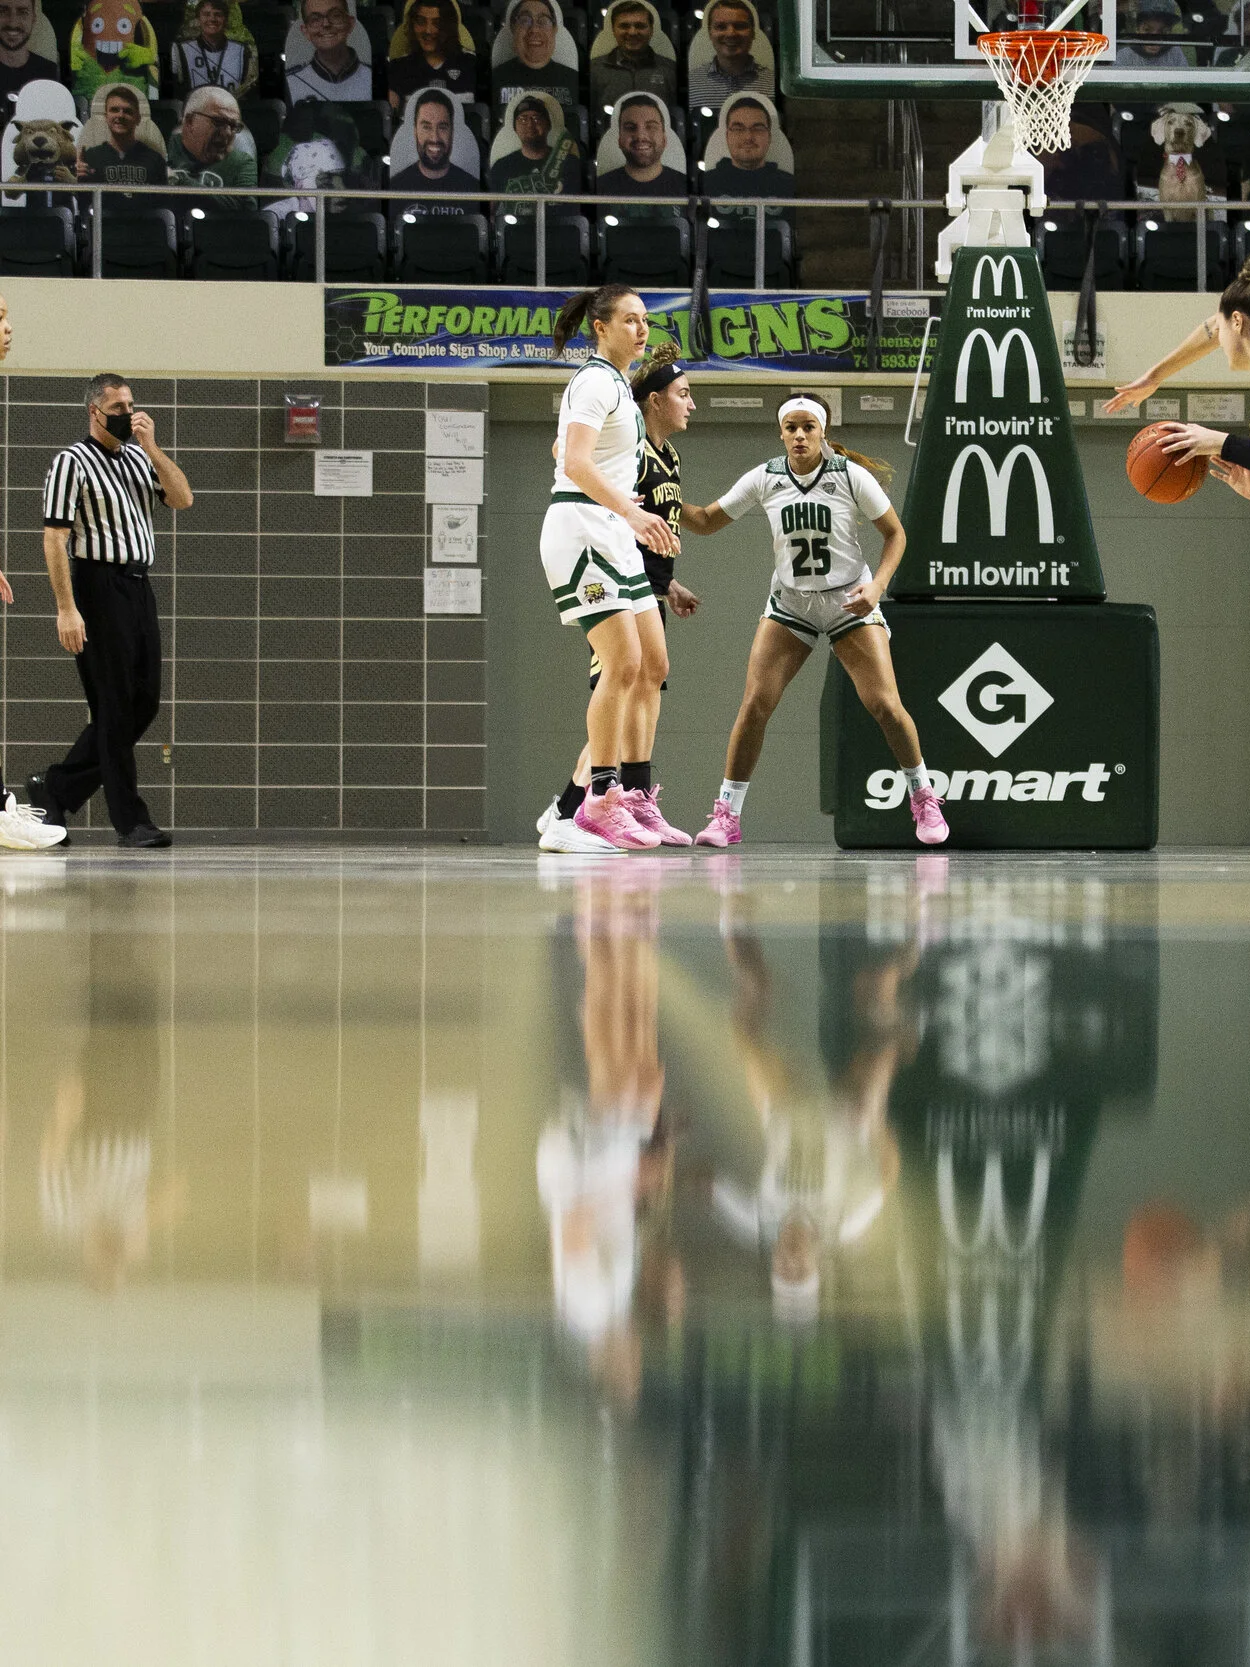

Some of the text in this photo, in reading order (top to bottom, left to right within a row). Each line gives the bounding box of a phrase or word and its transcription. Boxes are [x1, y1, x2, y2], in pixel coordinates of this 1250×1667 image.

[105, 164, 148, 183] OHIO
[886, 307, 928, 316] Facebook
[966, 306, 1031, 318] i'm lovin' it
[363, 341, 391, 355] Your
[393, 342, 447, 358] Complete
[449, 343, 475, 359] Sign
[478, 344, 508, 359] Shop
[510, 344, 521, 357] &
[945, 416, 1053, 436] i'm lovin' it
[781, 501, 831, 535] OHIO
[790, 536, 831, 577] 25
[929, 561, 1070, 586] i'm lovin' it
[965, 670, 1027, 726] G
